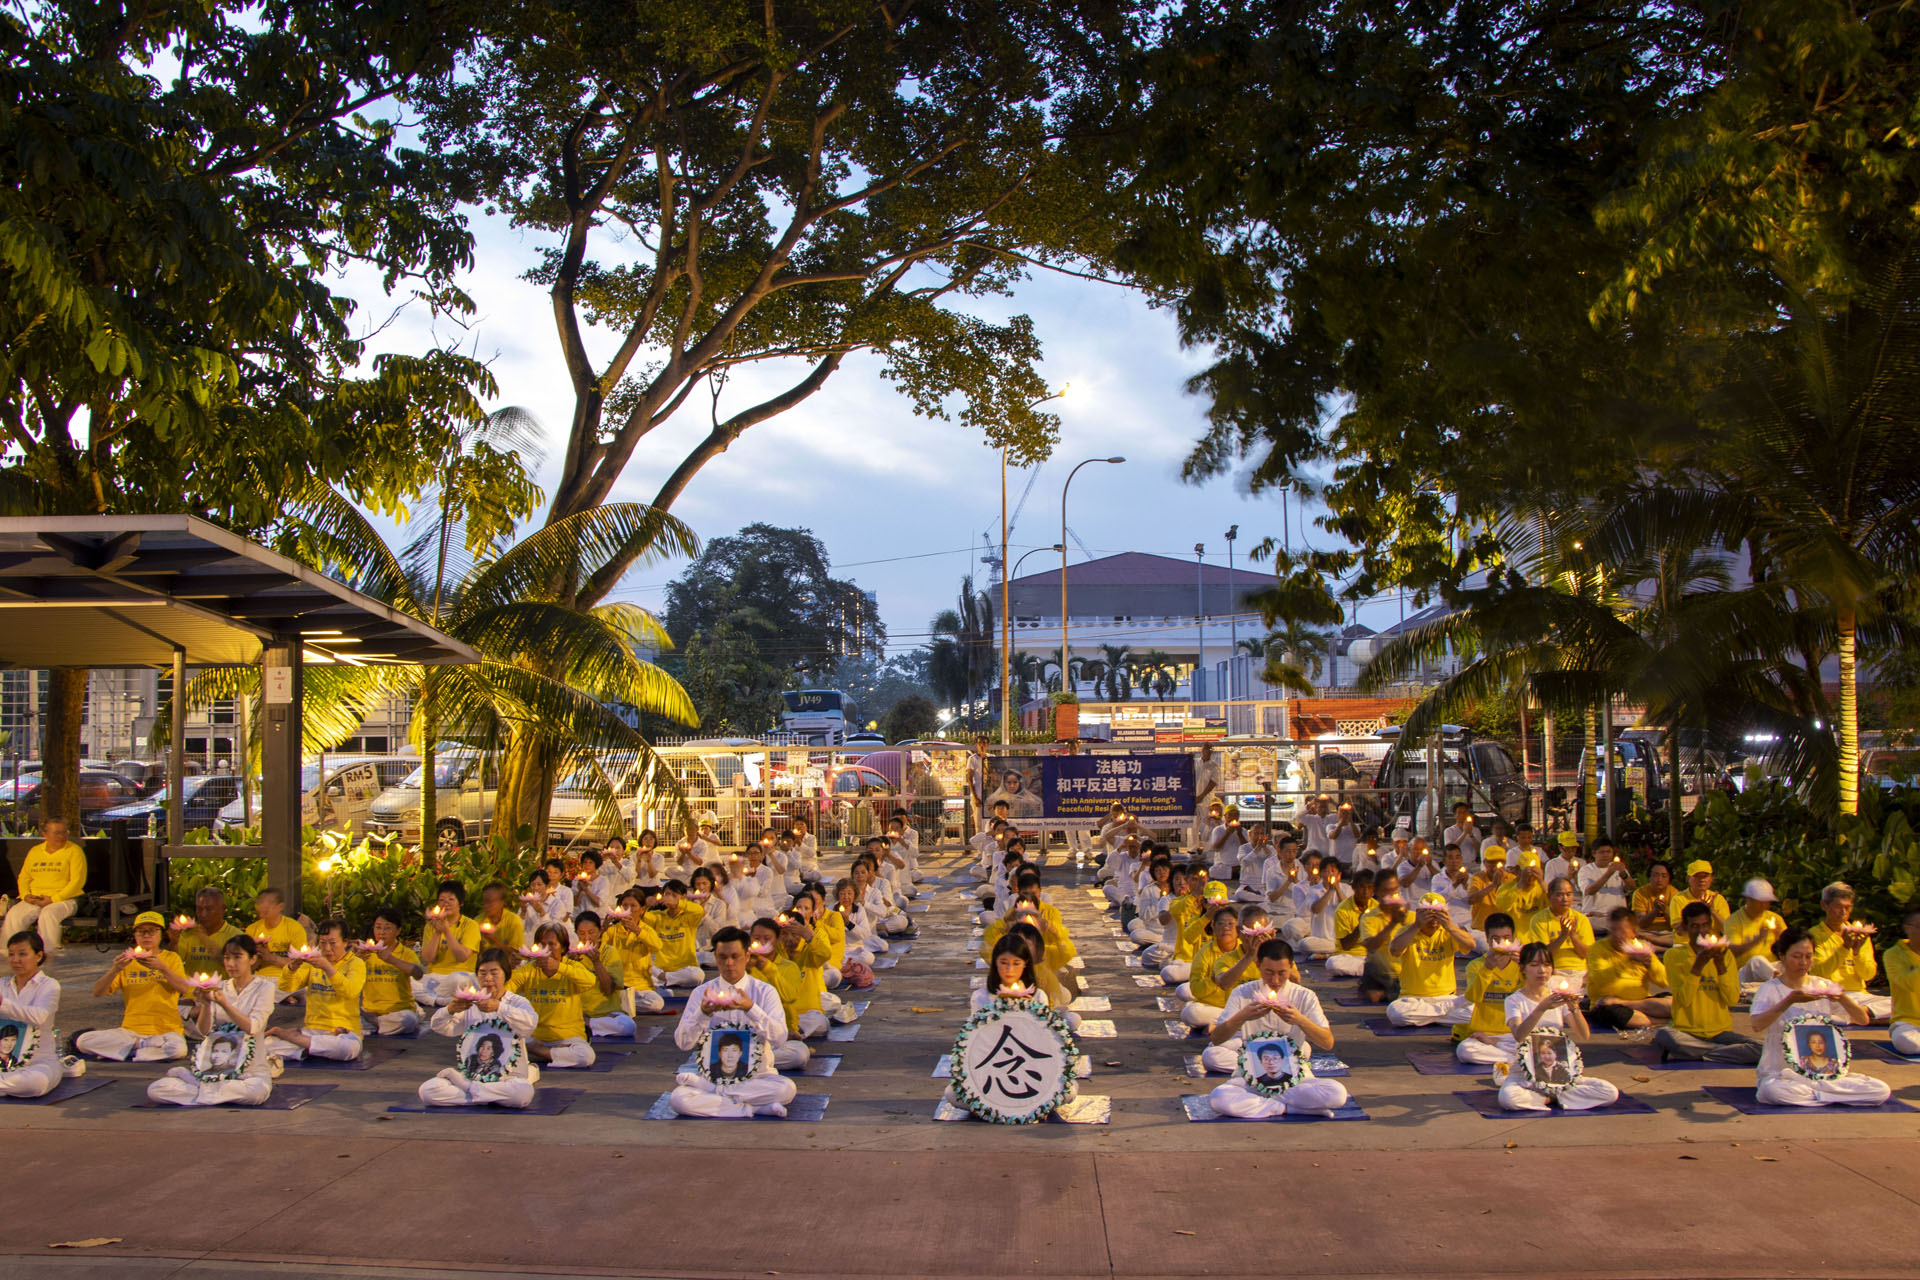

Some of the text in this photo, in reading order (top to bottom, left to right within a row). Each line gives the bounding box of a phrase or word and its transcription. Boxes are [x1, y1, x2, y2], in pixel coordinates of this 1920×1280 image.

[798, 695, 822, 706] JV49
[346, 765, 373, 783] RM5
[1096, 759, 1142, 775] 法輪功
[1057, 776, 1181, 793] 和平反迫害26週年
[1152, 796, 1176, 804] Gong's
[974, 1023, 1054, 1100] 念
